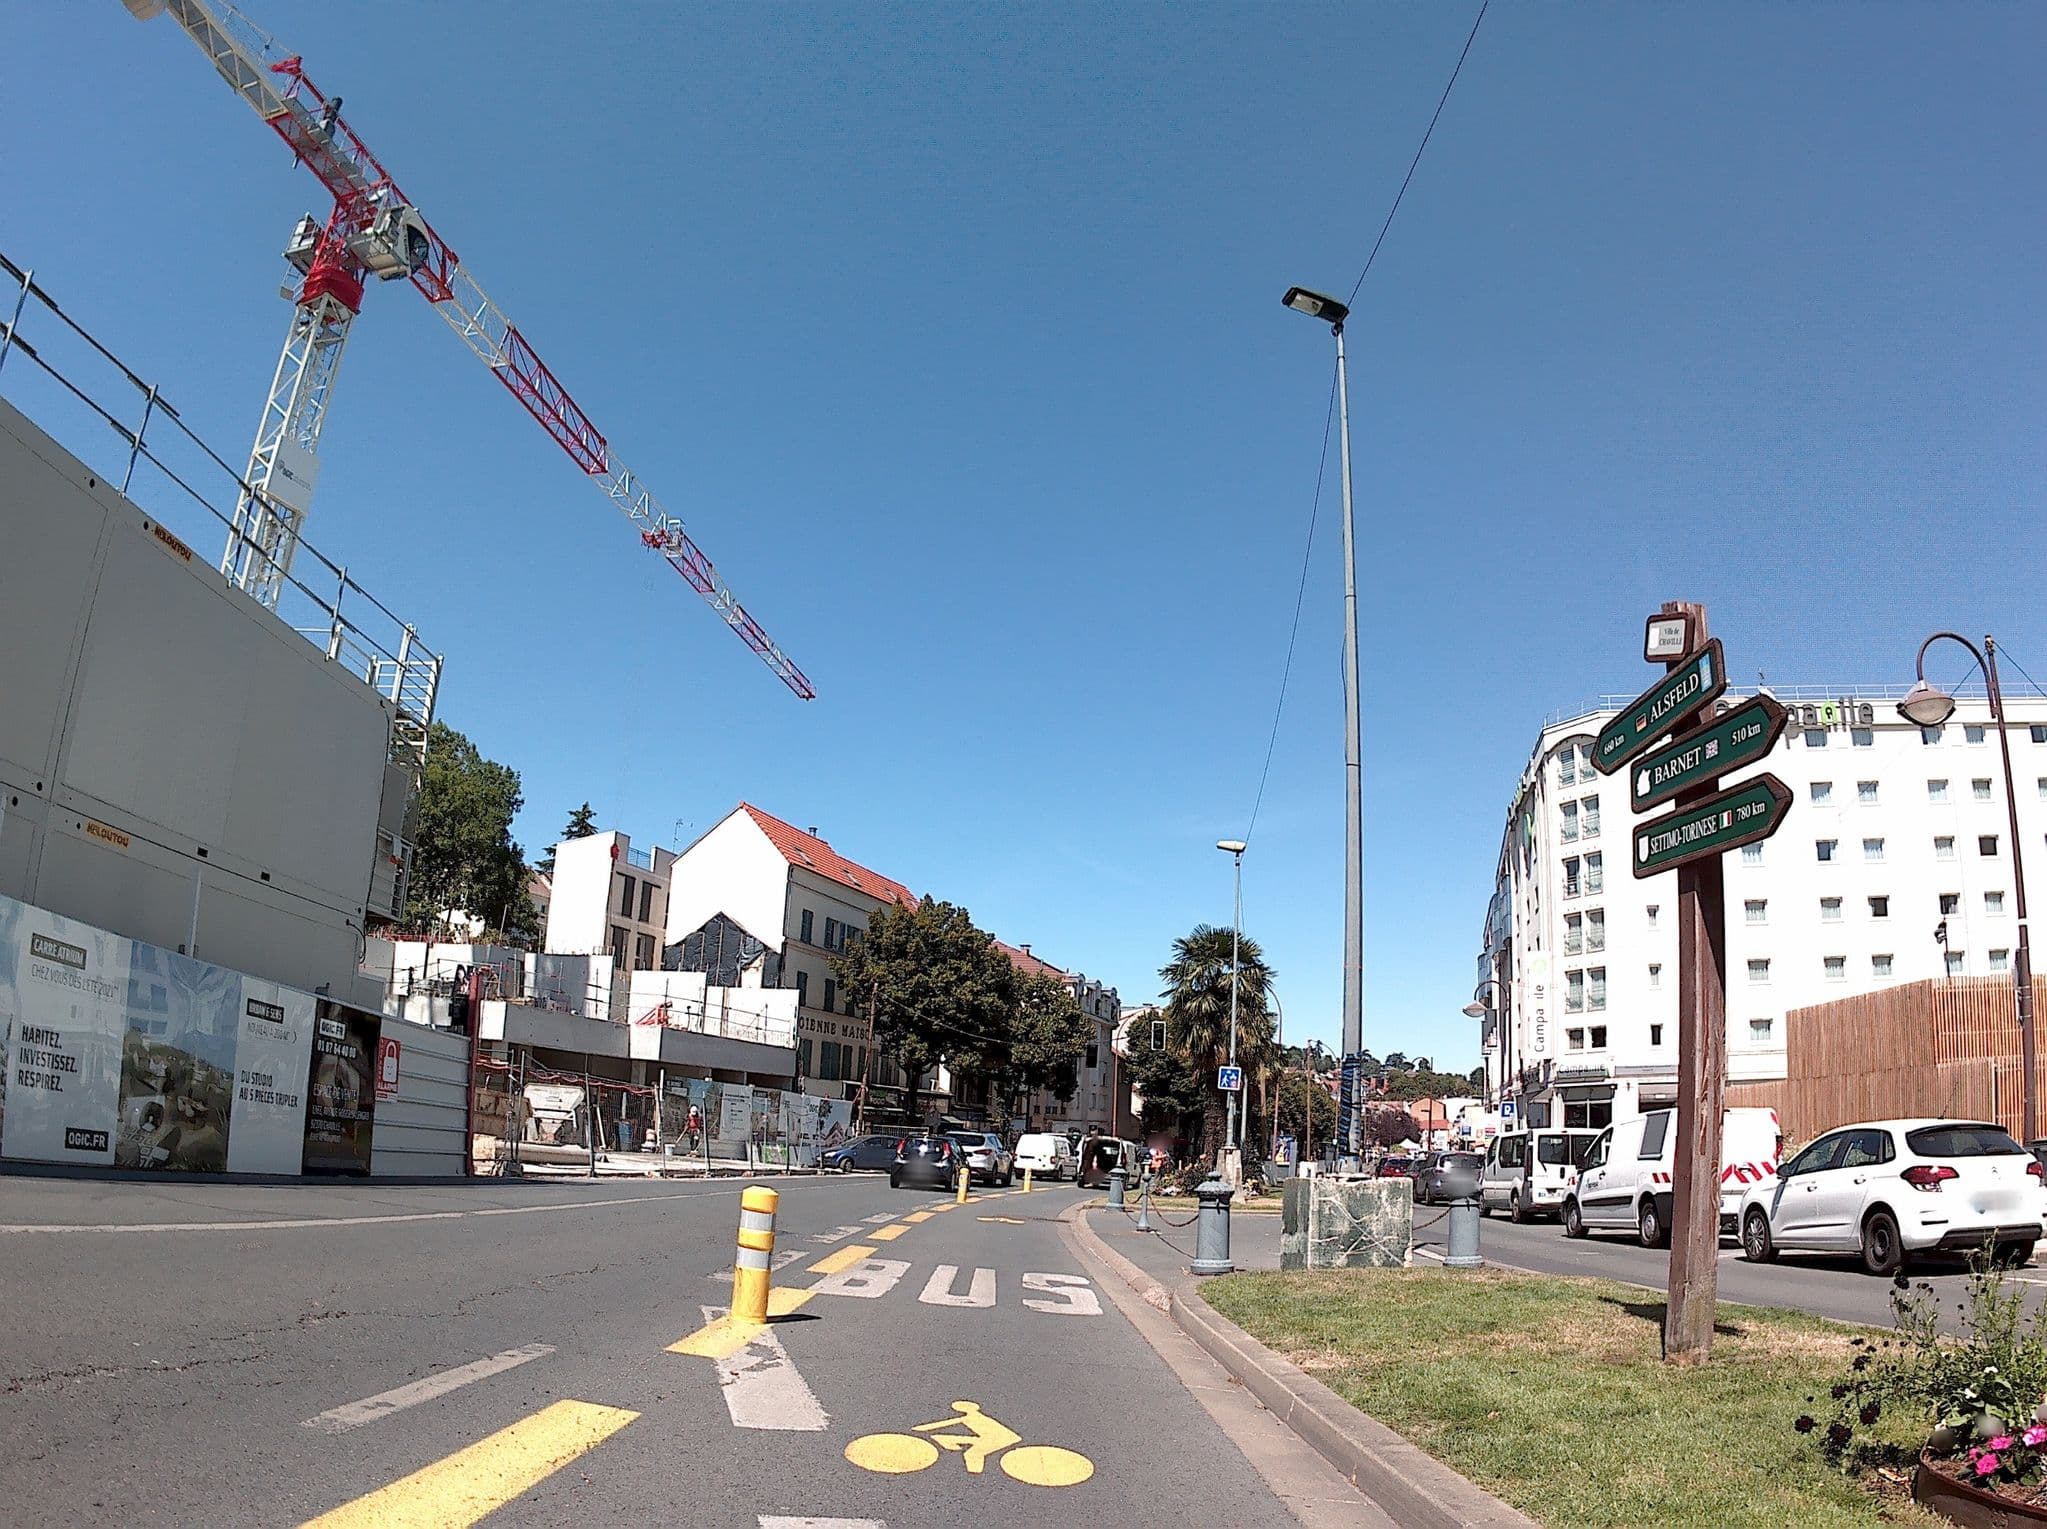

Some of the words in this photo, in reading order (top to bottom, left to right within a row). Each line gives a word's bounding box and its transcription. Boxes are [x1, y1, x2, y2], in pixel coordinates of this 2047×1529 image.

[1615, 734, 1625, 748] km
[1650, 673, 1699, 723] ALSFELD
[1654, 747, 1702, 785] BARNET
[1731, 727, 1747, 746] 510
[1747, 723, 1761, 738] km
[1650, 814, 1717, 855] SETTIMO-TORINESE
[1736, 807, 1751, 822] 780
[1751, 802, 1766, 816] km
[21, 1024, 62, 1049] HABITEZ.
[19, 1047, 78, 1073] INVESTISSEZ.
[18, 1069, 63, 1092] RESPIREZ.
[240, 1070, 250, 1084] DU
[251, 1072, 272, 1087] STUDIO
[239, 1087, 248, 1101] AU
[275, 1092, 298, 1108] TRIPLEX
[68, 1131, 106, 1148] OGIC.FR
[806, 1258, 1103, 1315] BUS
